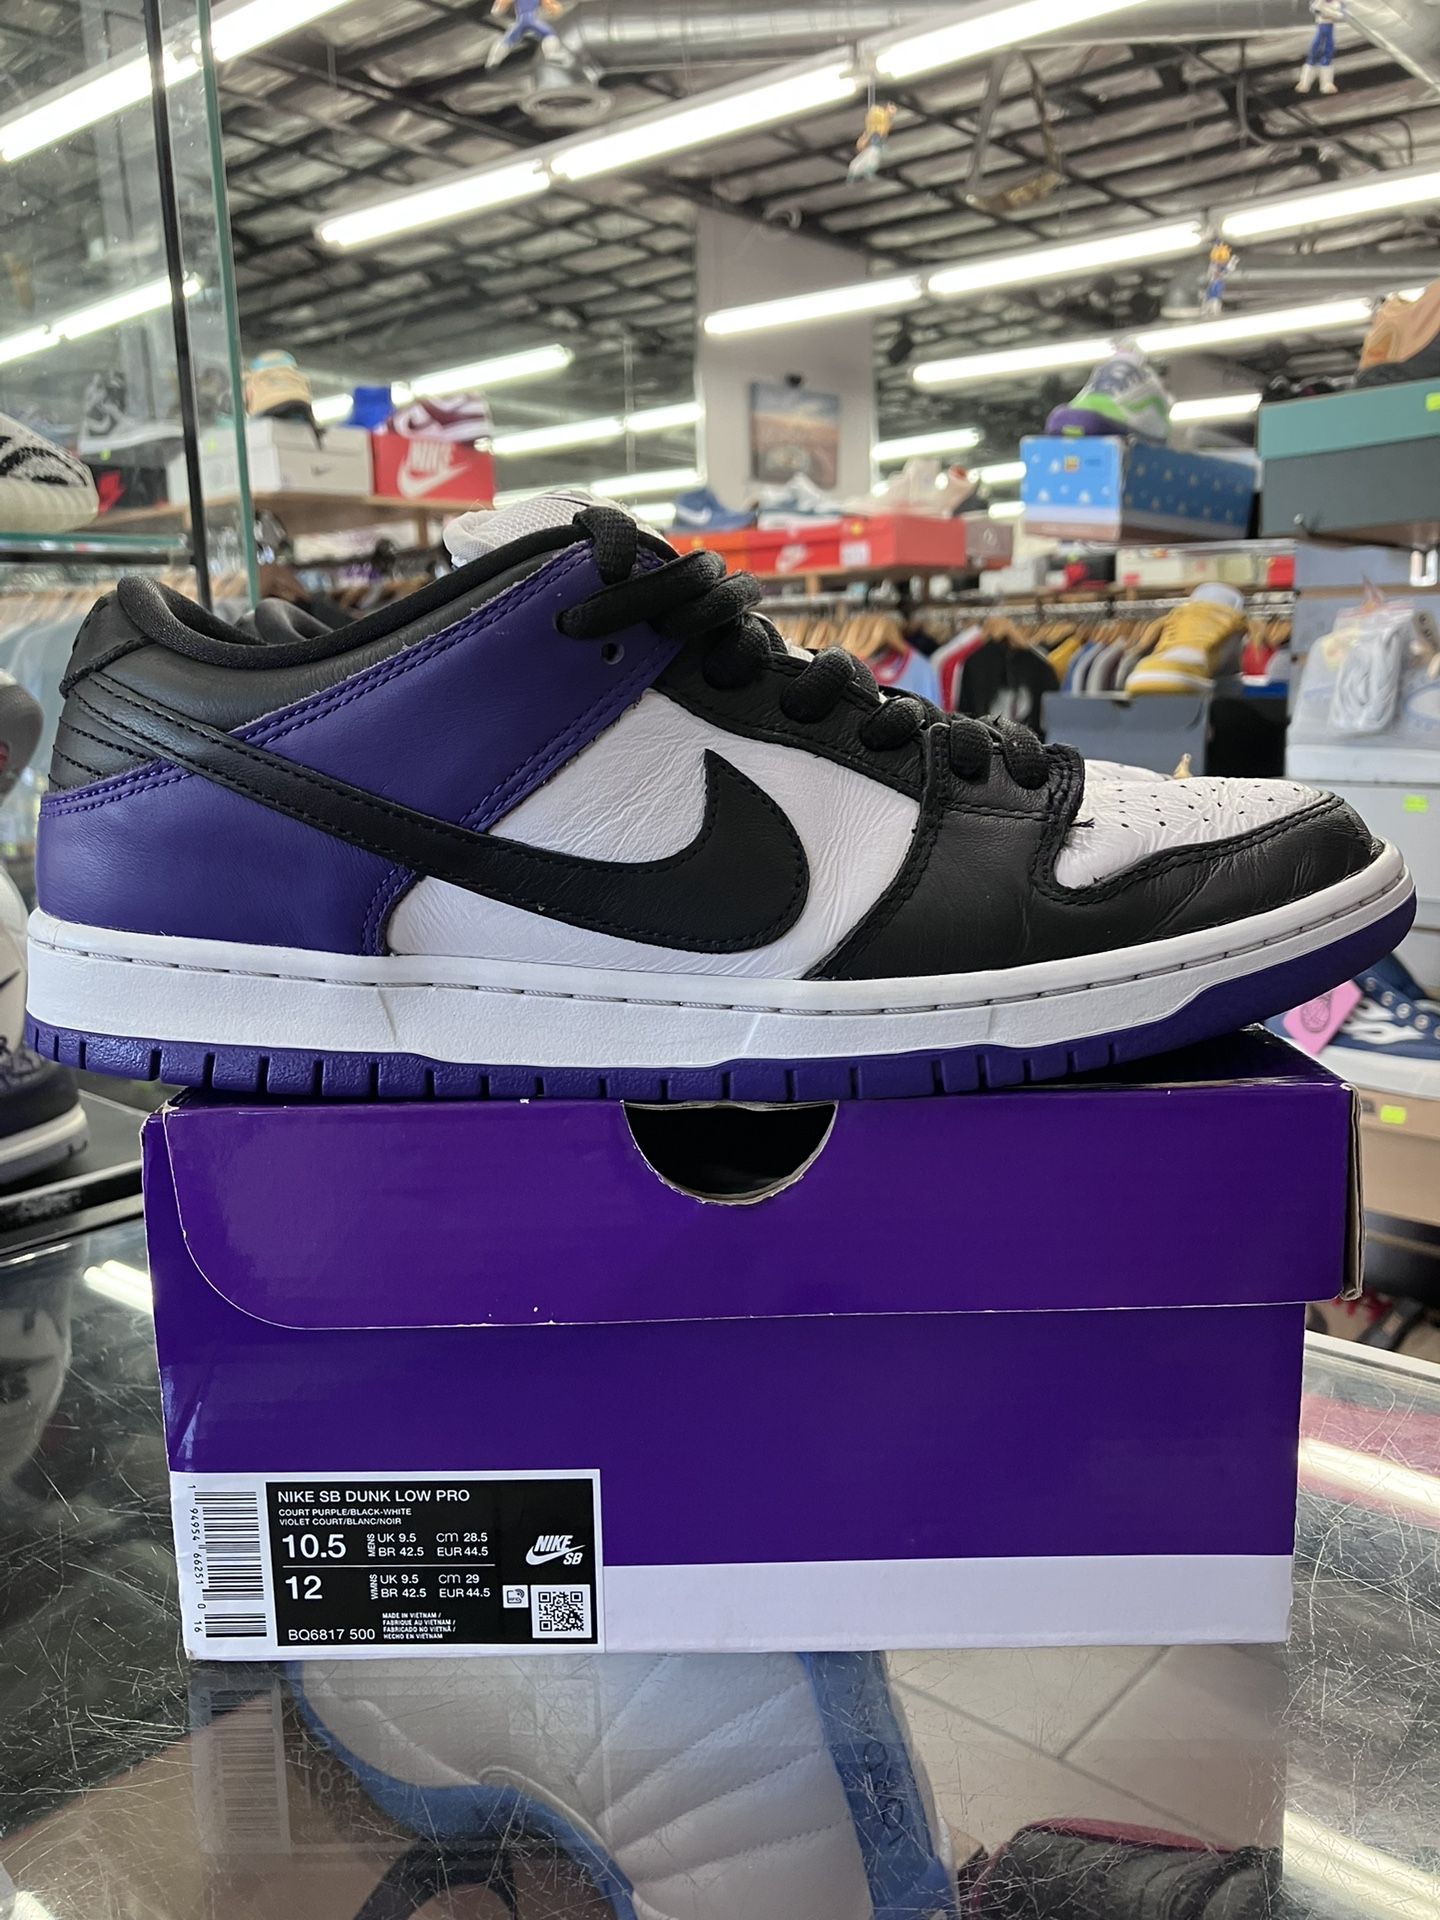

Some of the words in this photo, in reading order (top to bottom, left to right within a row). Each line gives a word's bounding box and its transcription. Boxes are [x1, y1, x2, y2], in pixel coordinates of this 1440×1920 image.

[277, 1490, 315, 1503] NIKE
[319, 1490, 341, 1503] SB
[345, 1490, 391, 1502] DUNK
[395, 1489, 431, 1502] LOW
[436, 1489, 470, 1502] PRO
[278, 1508, 310, 1517] COURT
[312, 1508, 412, 1516] PURPLE/BLACK-WHITE
[190, 1508, 200, 1541] 94954
[279, 1518, 310, 1526] VIOLET
[312, 1517, 402, 1525] COURT/BLANC/NOIR
[377, 1533, 395, 1543] UK
[398, 1533, 417, 1543] 9.5
[463, 1532, 488, 1542] 28.5
[533, 1535, 573, 1552] NIKE
[282, 1533, 347, 1559] 10.5
[366, 1533, 376, 1557] MENS
[378, 1547, 396, 1557] BR
[399, 1547, 424, 1556] 42.5
[437, 1547, 463, 1556] EUR
[464, 1546, 489, 1556] 44.5
[563, 1552, 583, 1565] SB
[193, 1553, 204, 1584] 66251
[380, 1574, 398, 1584] UK
[401, 1574, 419, 1584] 9.5
[465, 1574, 480, 1584] 29
[285, 1575, 323, 1600] 12
[369, 1573, 379, 1600] WMNS
[381, 1588, 399, 1598] BR
[402, 1588, 427, 1598] 42.5
[439, 1588, 464, 1598] EUR
[466, 1588, 491, 1597] 44.5
[194, 1620, 203, 1633] 16
[288, 1628, 345, 1641] BQ6817
[349, 1628, 376, 1640] 500
